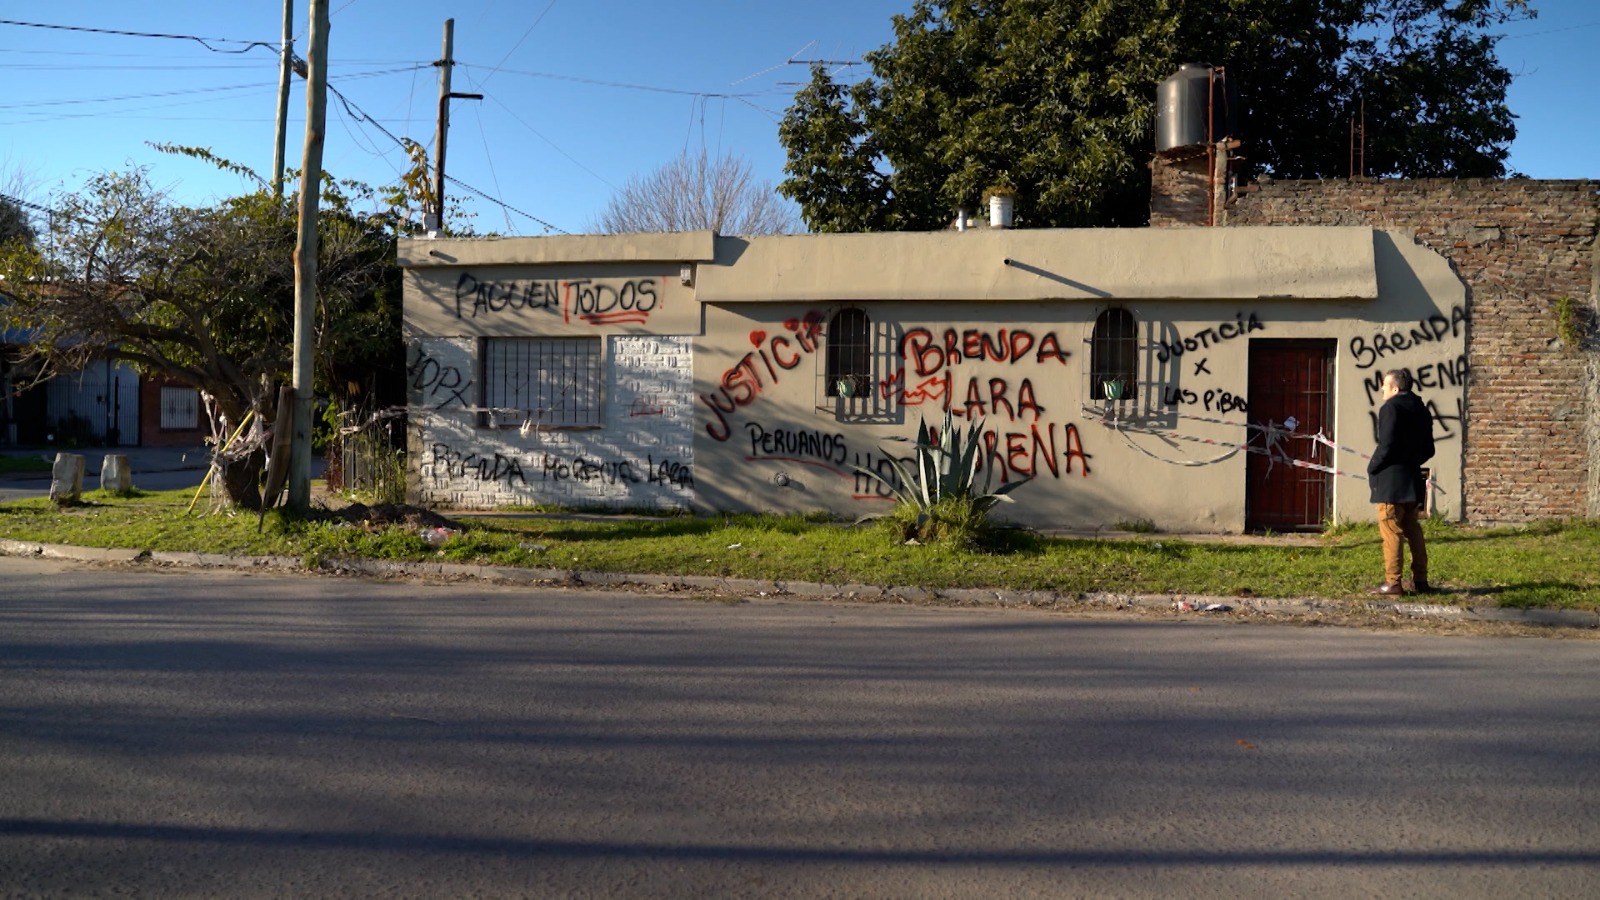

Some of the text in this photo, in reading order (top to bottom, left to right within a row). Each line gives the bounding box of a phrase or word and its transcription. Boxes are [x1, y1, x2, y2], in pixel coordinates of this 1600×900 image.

[456, 272, 559, 318] PAGUEN
[902, 327, 1071, 377] BRENDA
[942, 369, 1045, 423] LARA
[1164, 385, 1198, 405] LAS
[1364, 354, 1471, 406] MENA
[745, 421, 847, 466] PERUANOS
[929, 422, 1092, 483] RENA
